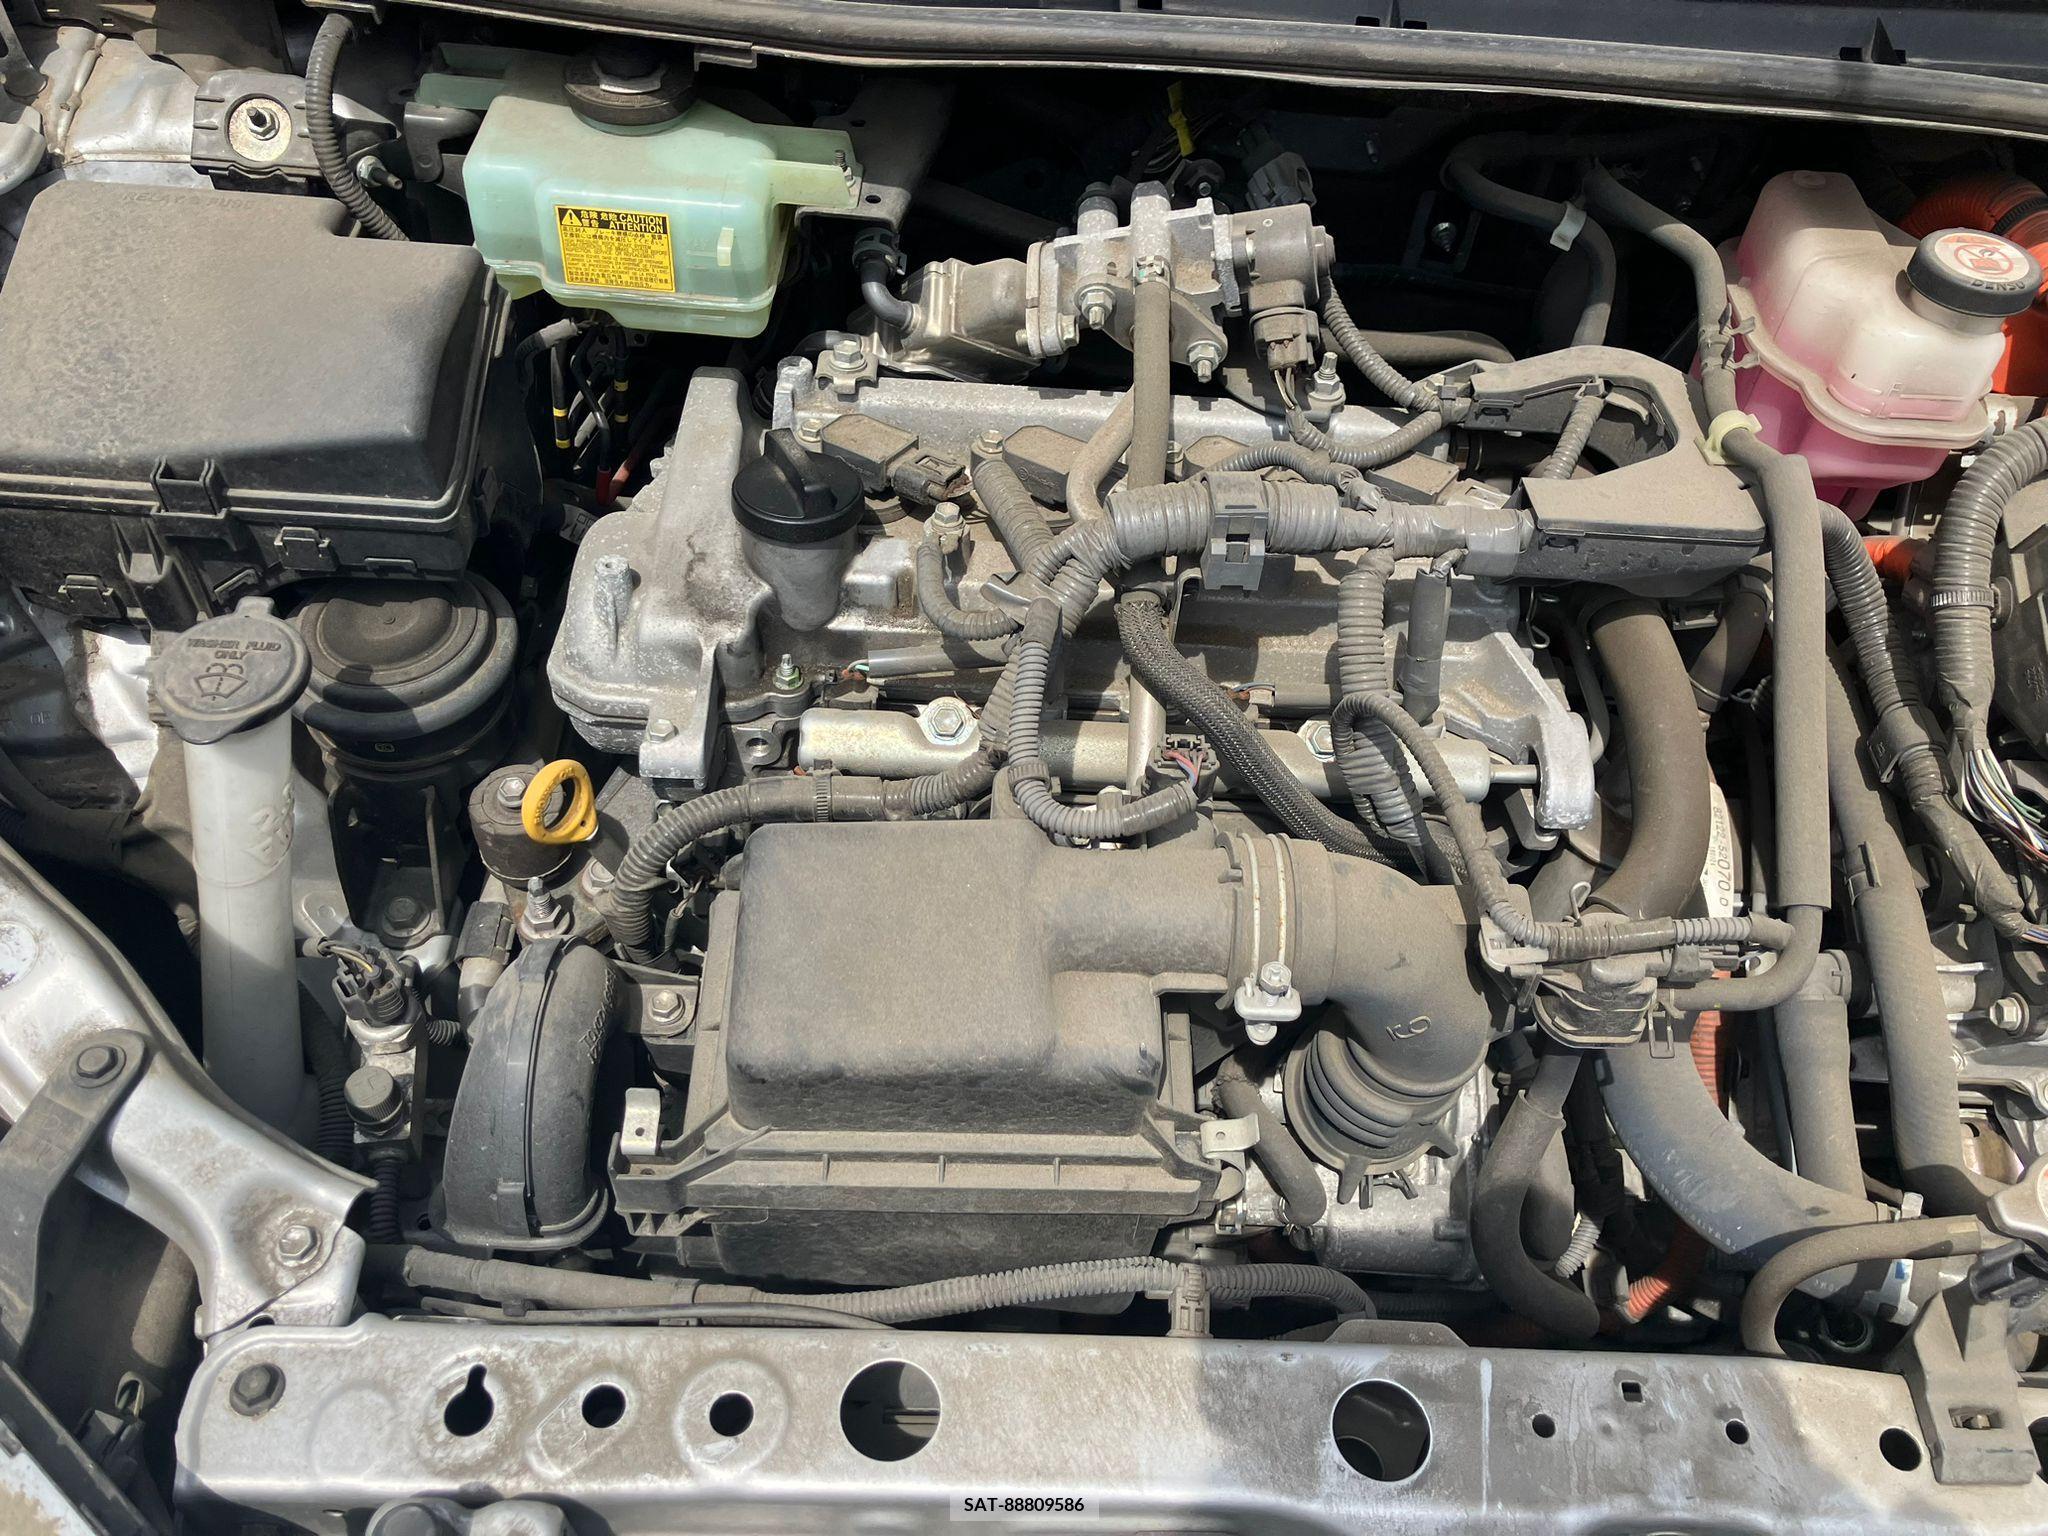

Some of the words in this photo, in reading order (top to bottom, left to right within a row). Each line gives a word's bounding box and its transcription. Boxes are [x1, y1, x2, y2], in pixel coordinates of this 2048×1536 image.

[619, 213, 663, 225] CAUTION
[609, 221, 664, 234] ATTENTION
[1971, 279, 2026, 291] DENSO
[187, 638, 240, 649] WASHER
[245, 640, 282, 652] FLUID
[214, 650, 248, 660] ONLY
